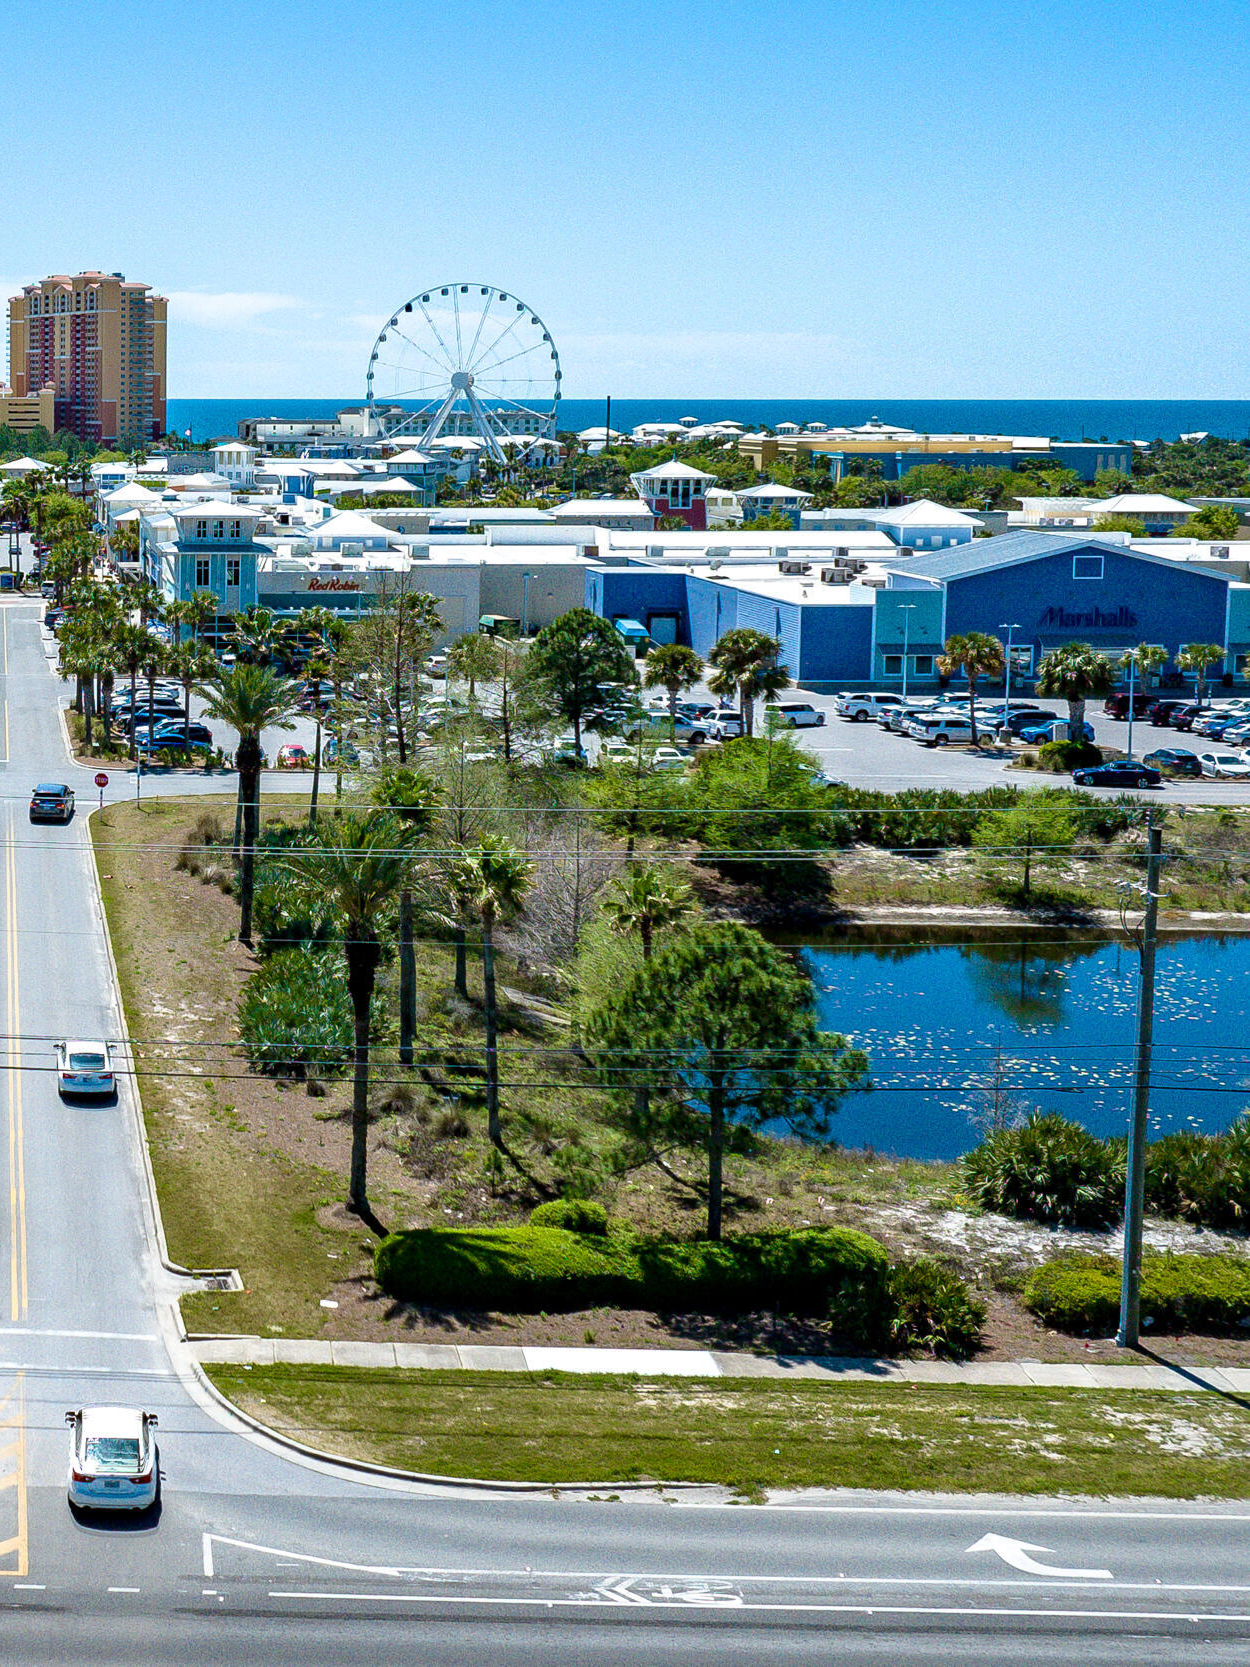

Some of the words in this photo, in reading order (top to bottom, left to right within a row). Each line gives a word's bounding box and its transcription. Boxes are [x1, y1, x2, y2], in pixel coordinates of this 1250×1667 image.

[308, 577, 330, 591] Red
[329, 577, 359, 591] Robin
[1036, 606, 1138, 628] Marshalls
[95, 776, 108, 784] STOP
